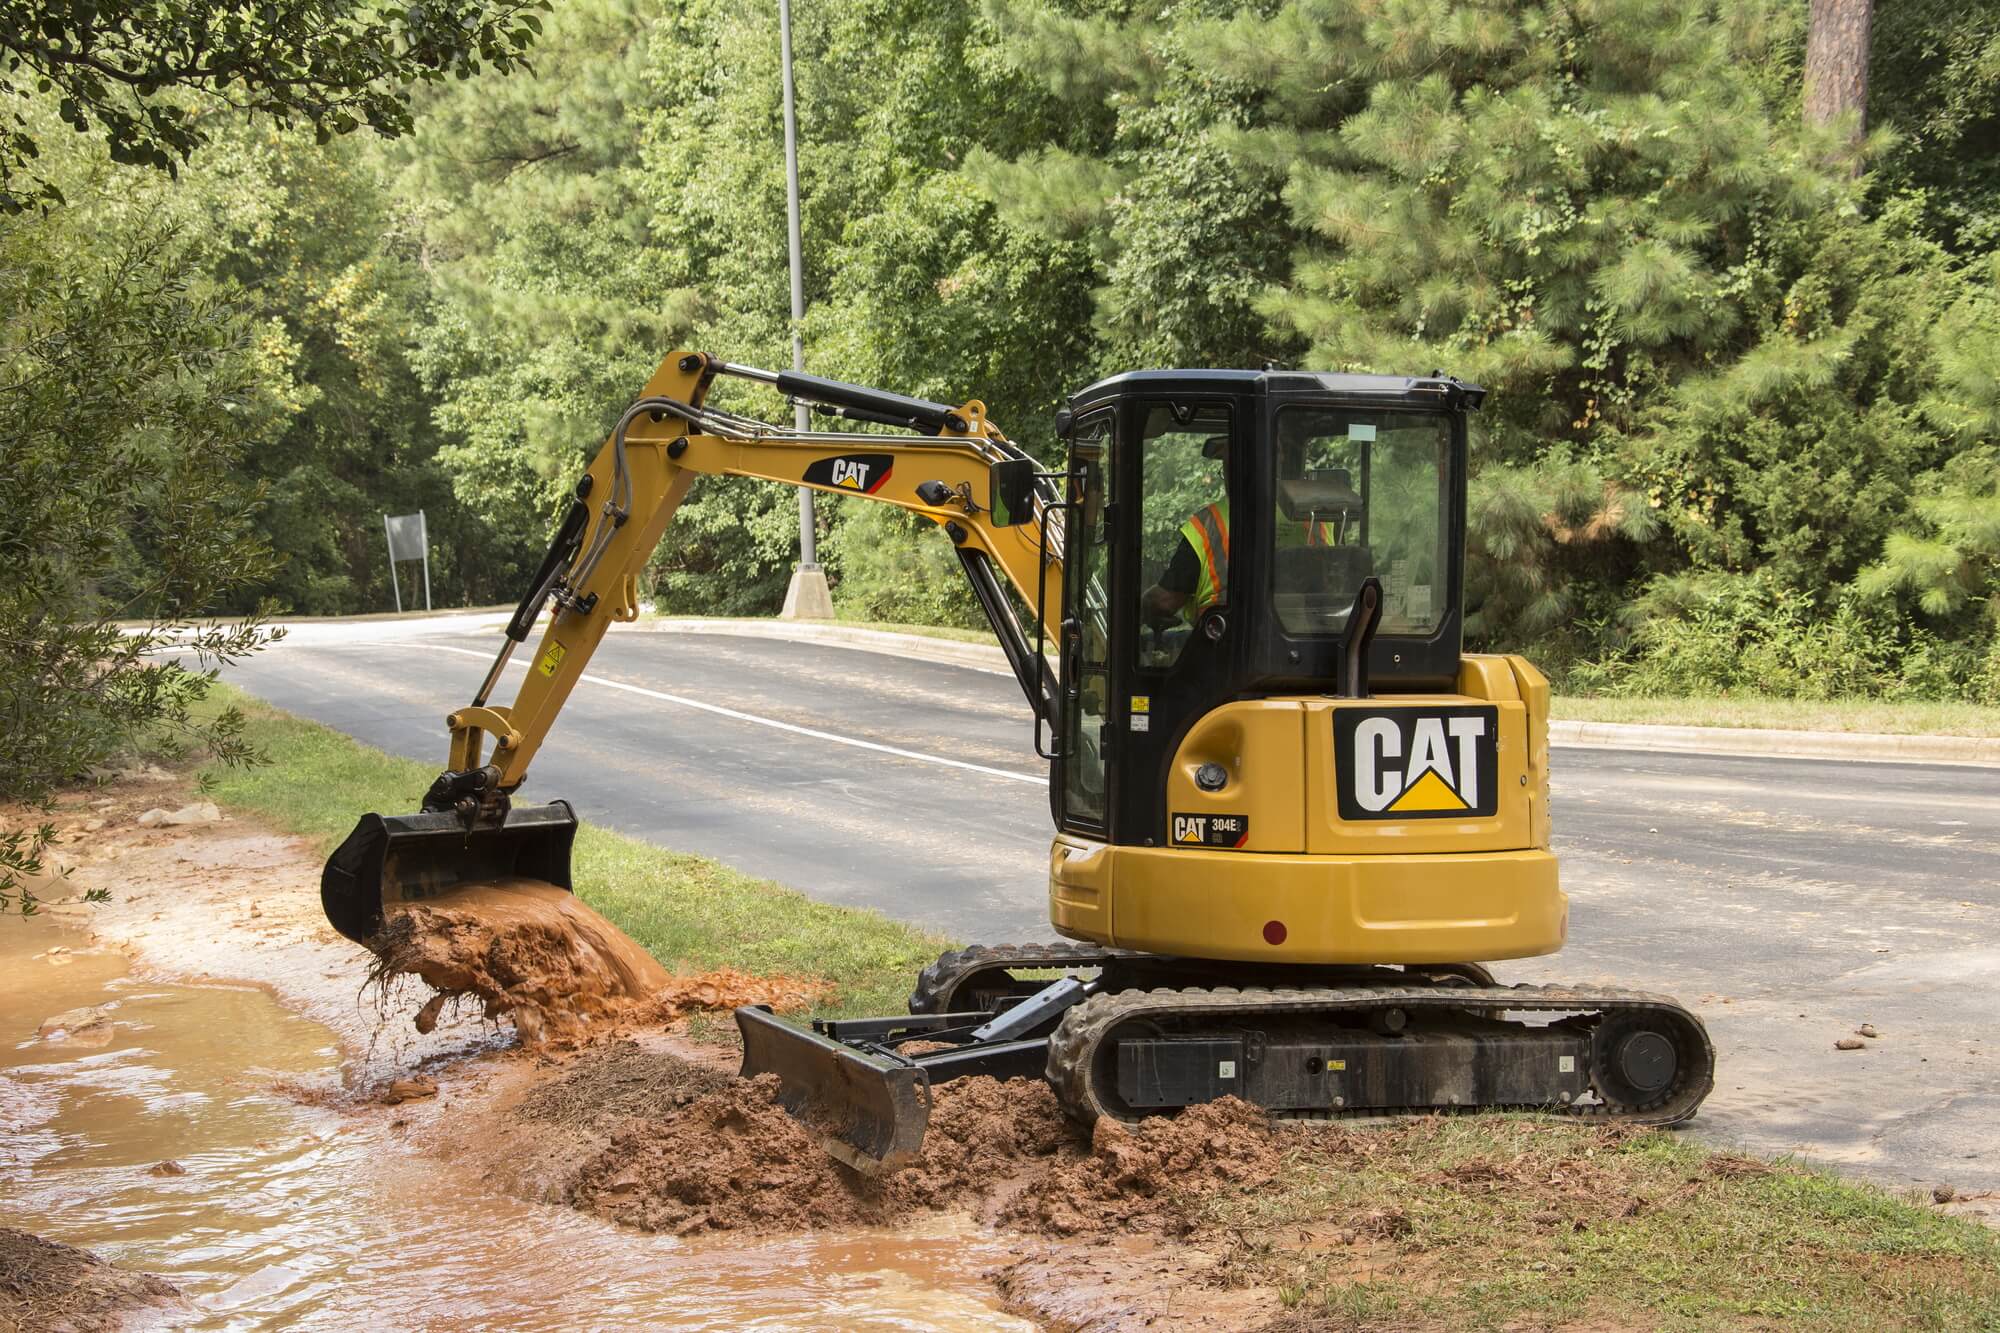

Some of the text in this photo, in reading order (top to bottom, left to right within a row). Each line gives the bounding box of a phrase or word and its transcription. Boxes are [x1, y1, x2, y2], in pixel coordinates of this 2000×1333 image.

[831, 458, 870, 491] CAT
[1354, 716, 1485, 812] CAT
[1174, 816, 1207, 842] CAT
